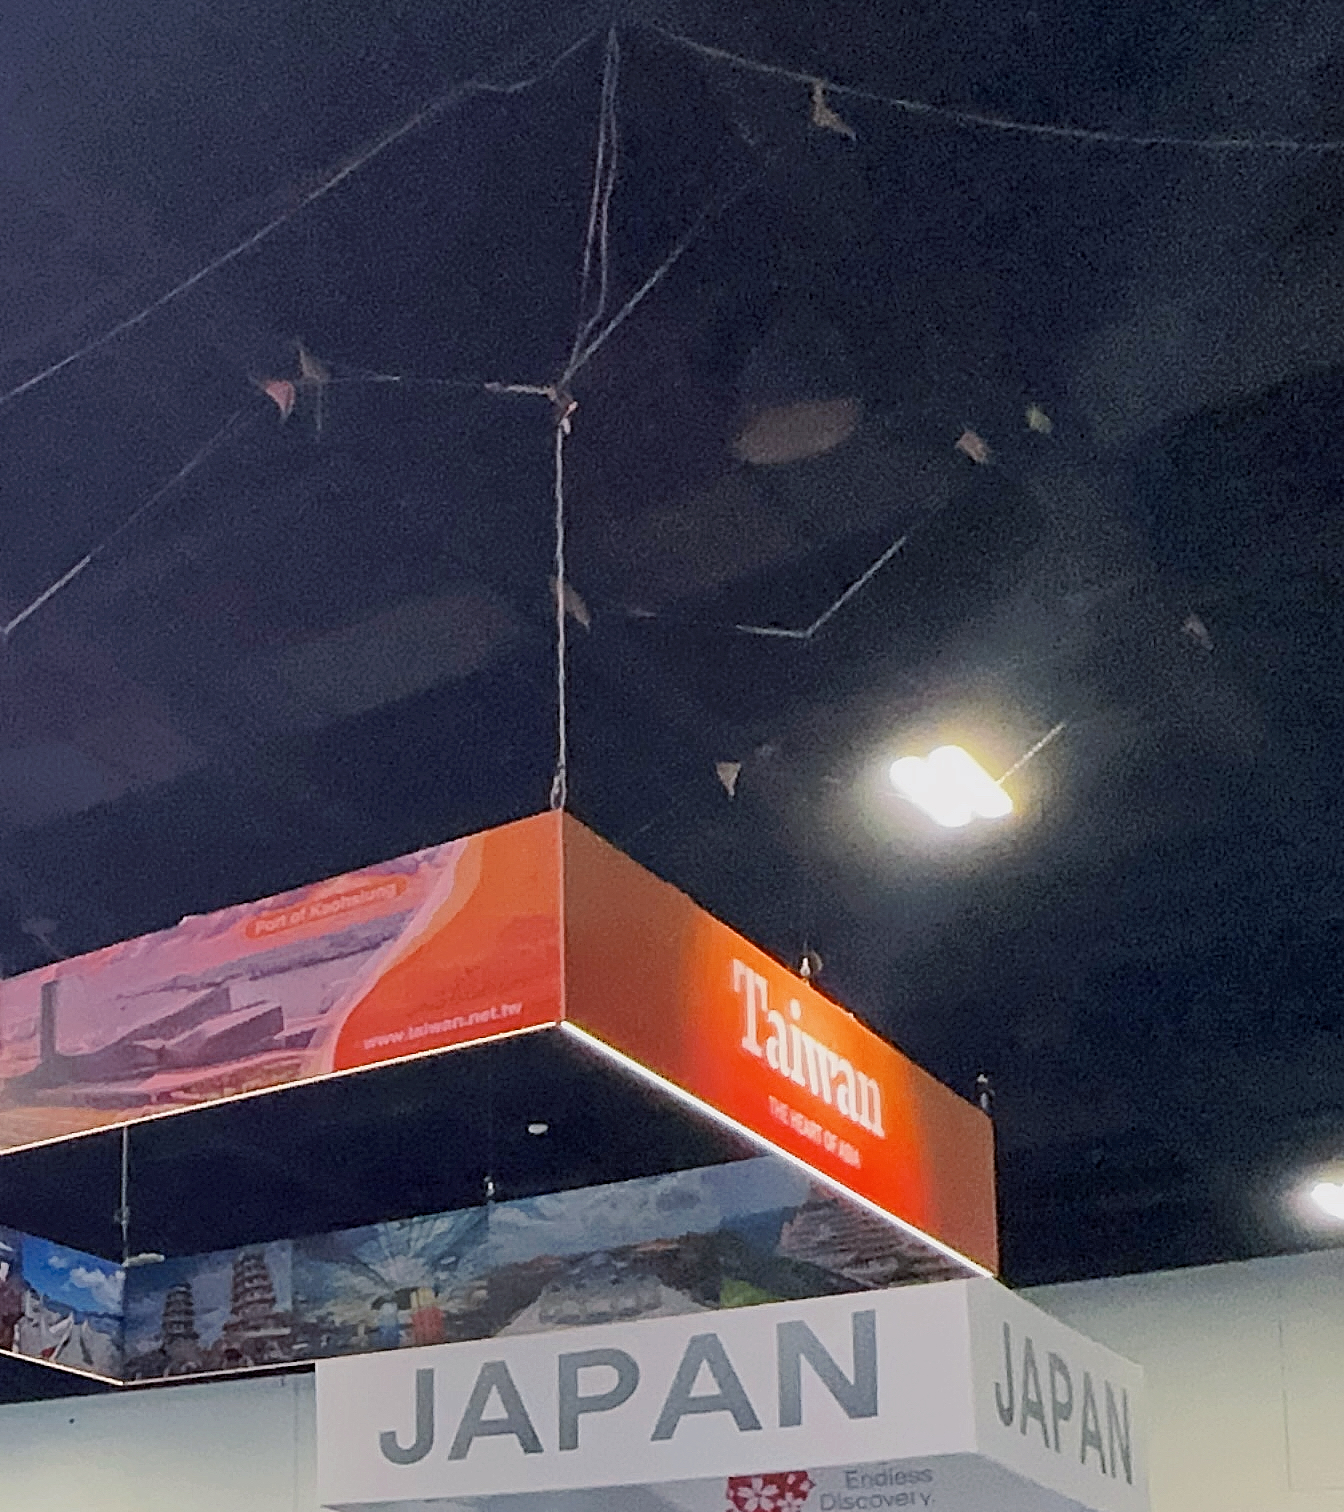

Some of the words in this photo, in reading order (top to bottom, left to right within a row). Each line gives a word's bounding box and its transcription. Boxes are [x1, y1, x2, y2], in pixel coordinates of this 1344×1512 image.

[363, 1000, 524, 1050] www.taiwan.net.tw
[732, 958, 886, 1139] Taiwan
[378, 1308, 879, 1466] JAPAN
[993, 1321, 1134, 1486] JAPAN
[844, 1468, 933, 1491] Endless
